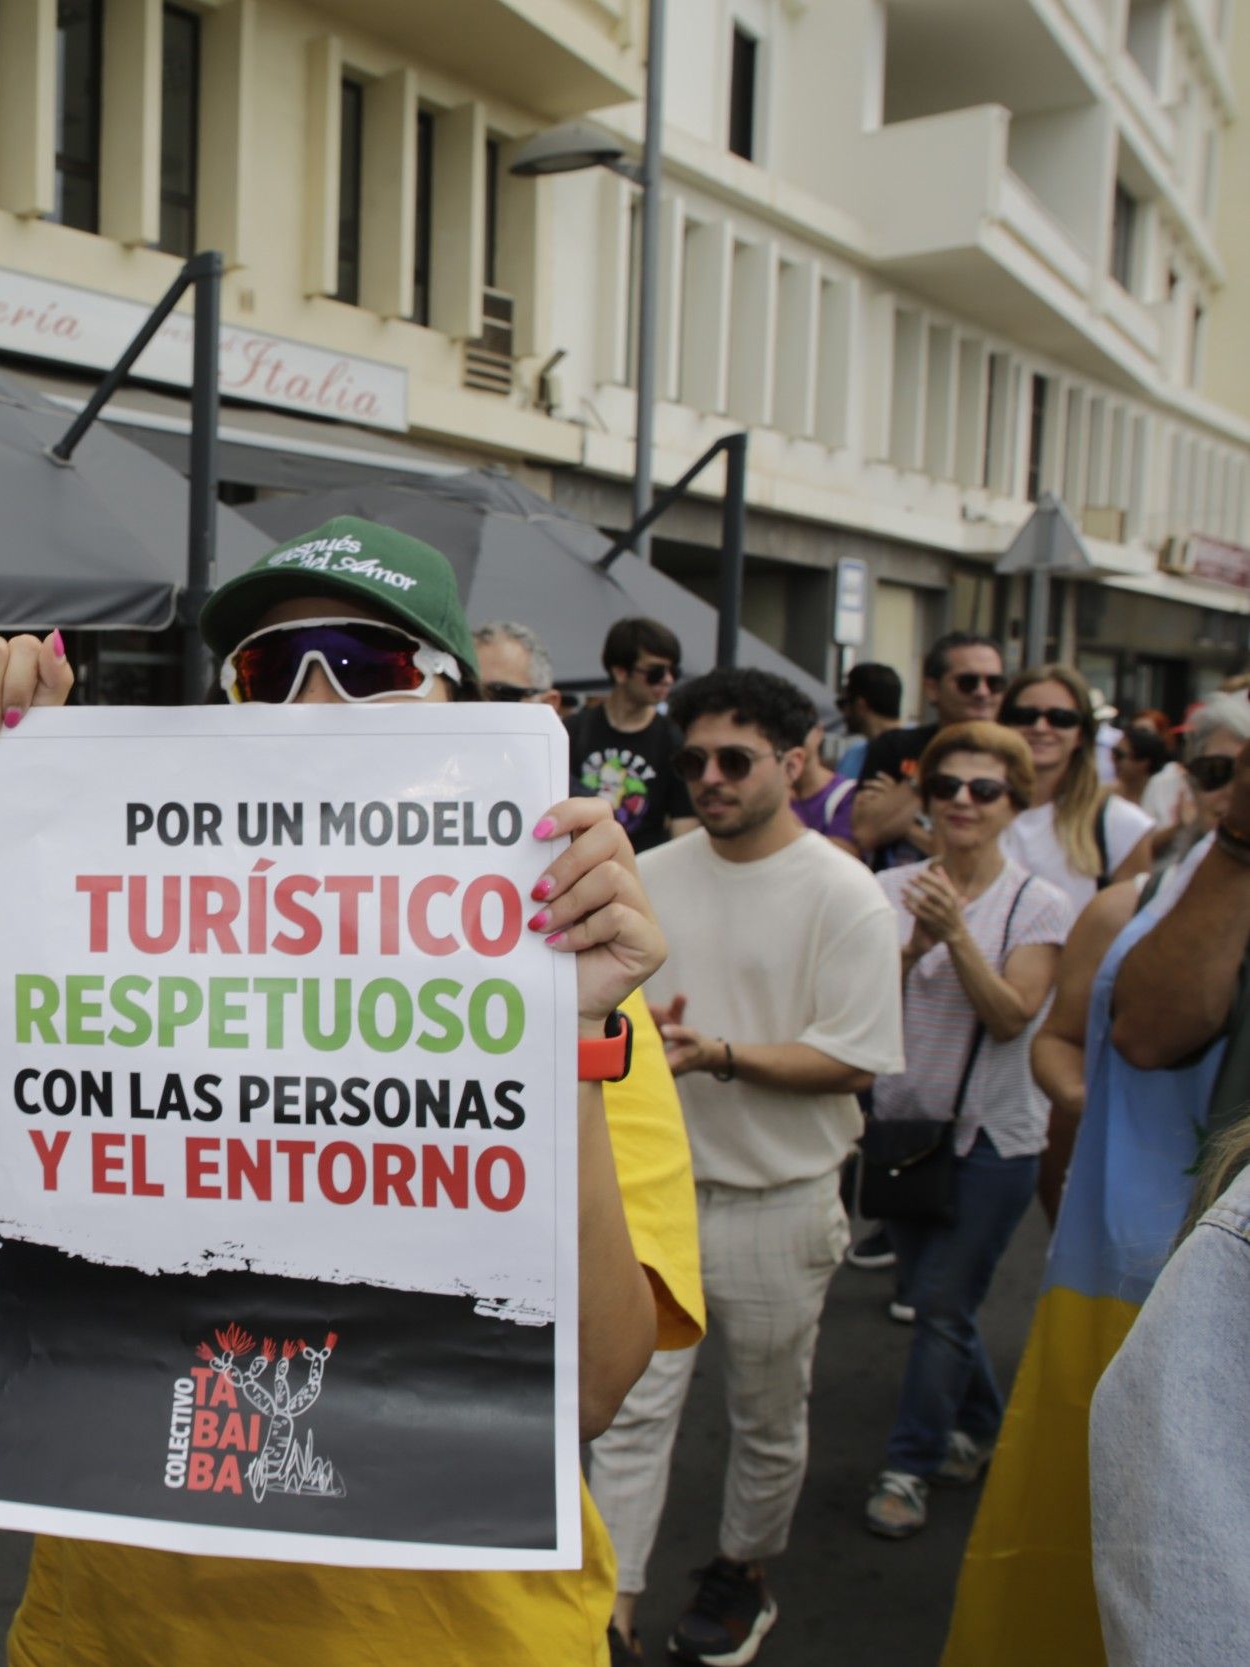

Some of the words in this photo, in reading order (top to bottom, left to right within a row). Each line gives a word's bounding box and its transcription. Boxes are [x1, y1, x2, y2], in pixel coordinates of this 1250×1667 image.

[218, 335, 382, 418] Italia
[331, 556, 418, 593] Amor
[126, 802, 222, 846] POR
[238, 802, 303, 846] UN
[320, 800, 523, 847] MODELO
[76, 857, 523, 957] TURÍSTICO
[15, 974, 525, 1054] RESPETUOSO
[13, 1068, 113, 1118] CON
[129, 1072, 223, 1122] LAS
[239, 1075, 526, 1131] PERSONAS
[29, 1130, 71, 1191] Y
[91, 1132, 165, 1197] EL
[185, 1136, 526, 1213] ENTORNO
[190, 1367, 239, 1409] TA
[164, 1377, 195, 1488] COLECTIVO
[191, 1410, 261, 1453] BAI
[186, 1452, 243, 1496] BA
